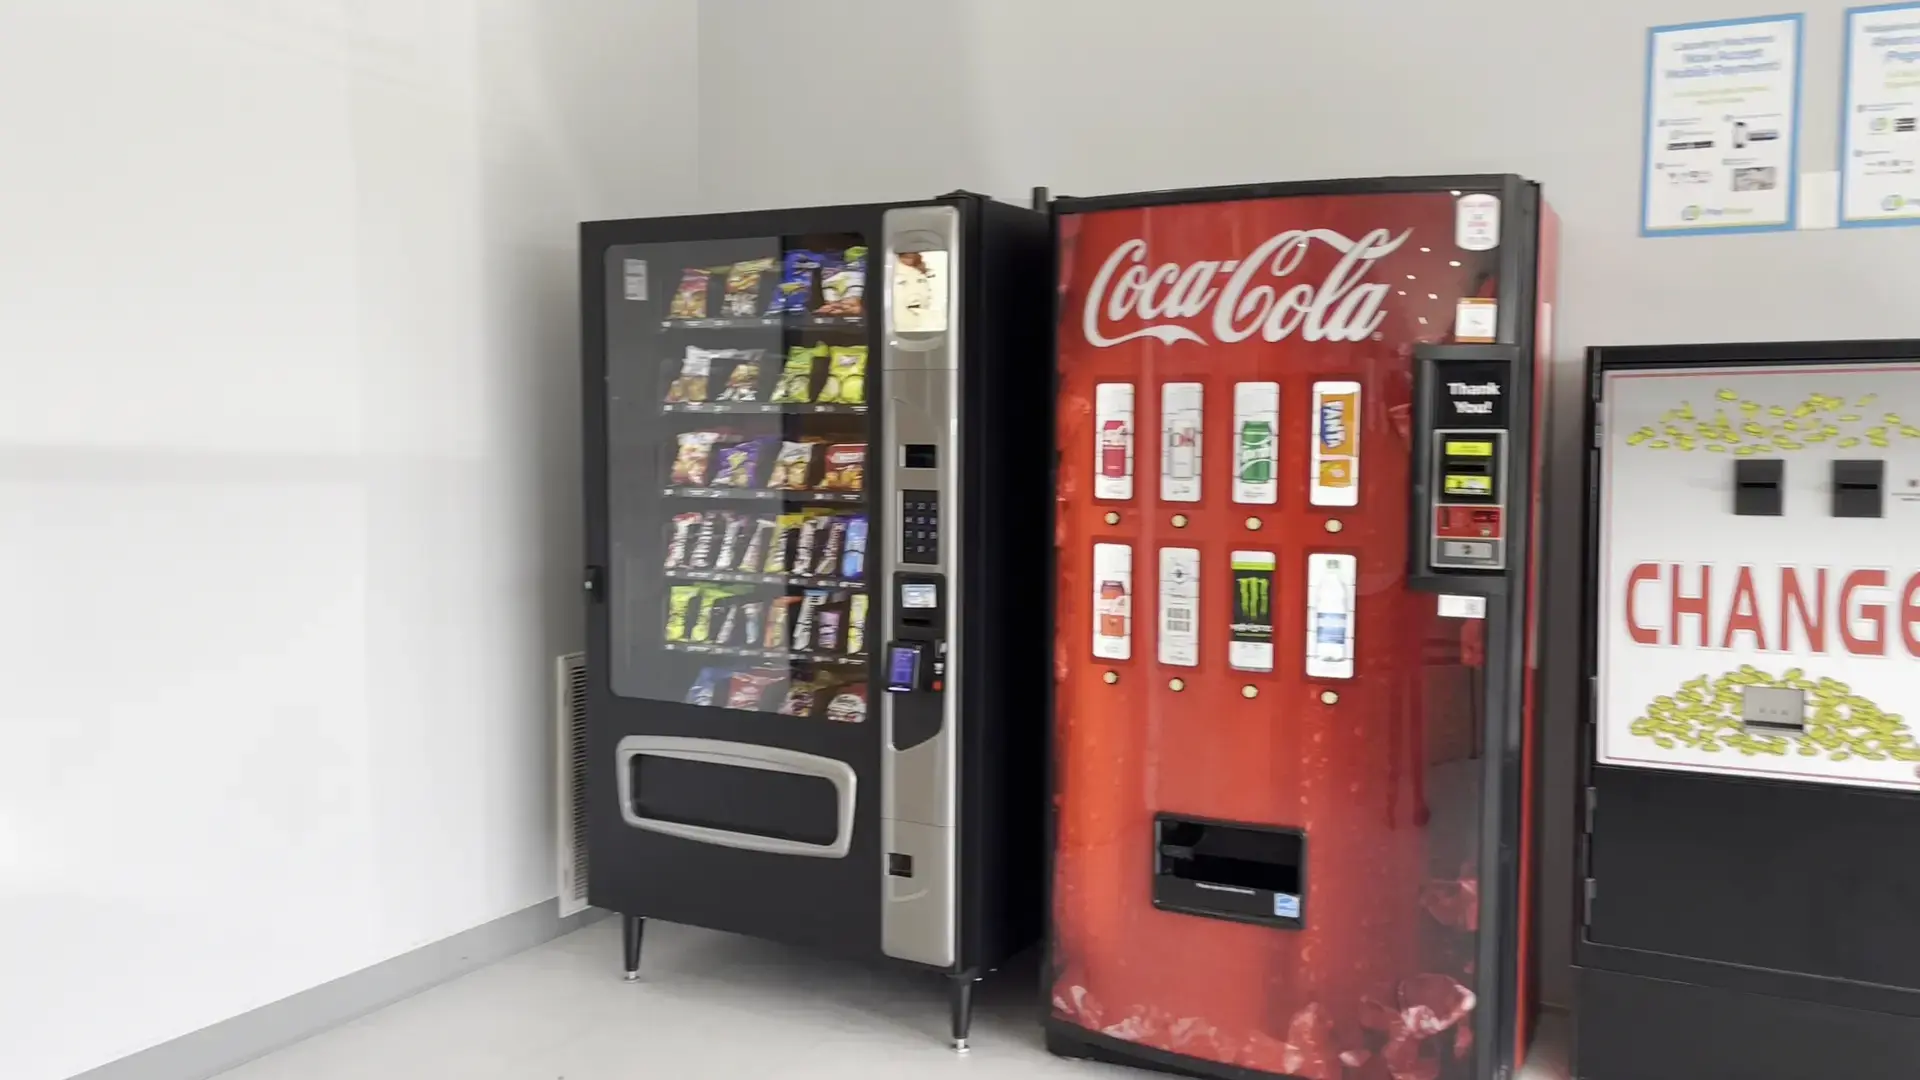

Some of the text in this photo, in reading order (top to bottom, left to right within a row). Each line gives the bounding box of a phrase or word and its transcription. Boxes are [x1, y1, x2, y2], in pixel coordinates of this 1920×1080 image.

[1083, 227, 1414, 348] Coca-Cola
[1446, 382, 1502, 396] Thank
[1452, 400, 1494, 414] You!
